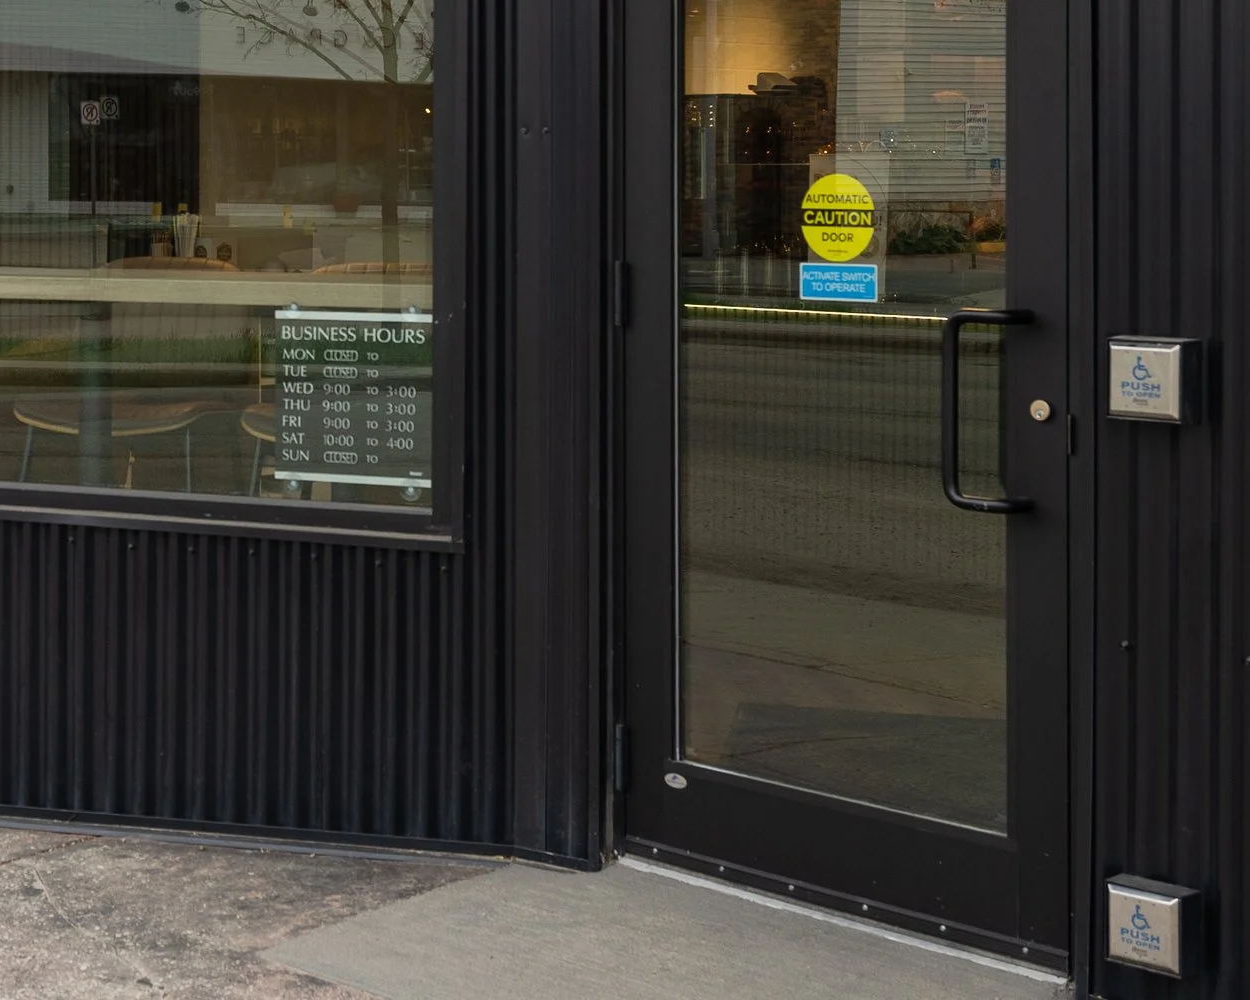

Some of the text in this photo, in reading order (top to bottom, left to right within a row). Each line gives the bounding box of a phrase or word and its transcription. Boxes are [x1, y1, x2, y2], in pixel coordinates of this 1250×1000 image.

[806, 194, 869, 204] AUTOMATIC
[804, 211, 872, 225] CAUTION
[822, 232, 854, 242] DOOR
[802, 272, 876, 282] ACTIVATE SWITCH
[812, 282, 866, 293] TO OPERATE
[281, 326, 425, 344] BUSINESS HOURS
[283, 349, 379, 362] MON CLOSED TO
[283, 365, 378, 378] TUE CLOSED TO
[283, 383, 416, 398] WED 9:00 TO 3:00
[1121, 381, 1161, 391] PUSH
[284, 399, 415, 415] THU 9:00 TO 3:00
[283, 416, 414, 432] FRI 9:00 TO 3:00
[283, 433, 413, 450] SAT 10:00 TO 4:00
[283, 450, 378, 464] SUN CLOSED TO
[1120, 928, 1160, 944] PUSH
[1136, 941, 1160, 951] OPEN
